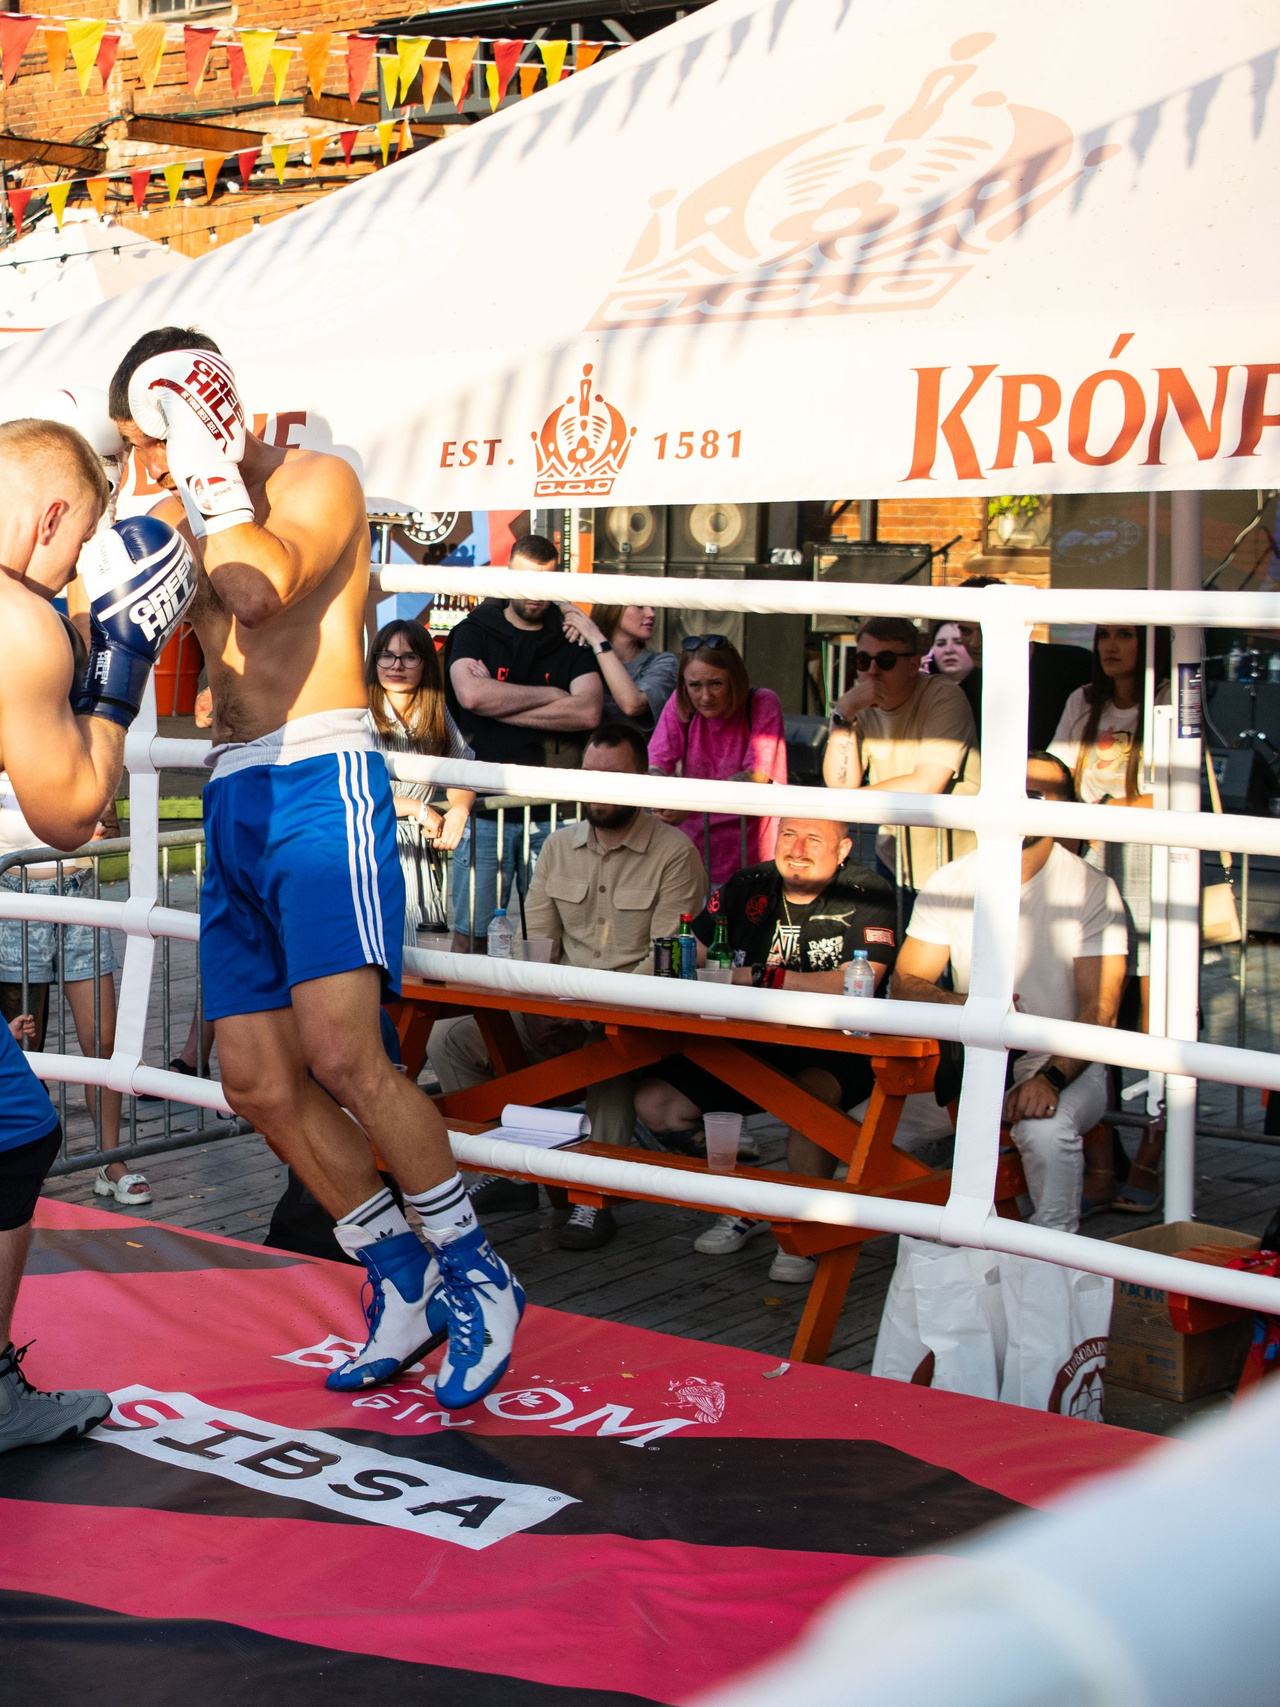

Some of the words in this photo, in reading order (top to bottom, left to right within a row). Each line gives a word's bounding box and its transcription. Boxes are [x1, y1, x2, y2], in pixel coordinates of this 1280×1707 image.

[183, 369, 235, 441] HILL
[193, 359, 246, 430] GREE
[205, 420, 220, 435] SELF
[439, 438, 514, 468] EST.
[654, 429, 742, 460] 1581
[128, 544, 194, 625] GREEN
[139, 577, 195, 642] HILL
[94, 651, 105, 680] HILL
[271, 1333, 700, 1448] BOM
[352, 1393, 476, 1428] GIN
[97, 1399, 507, 1529] SIBSA
